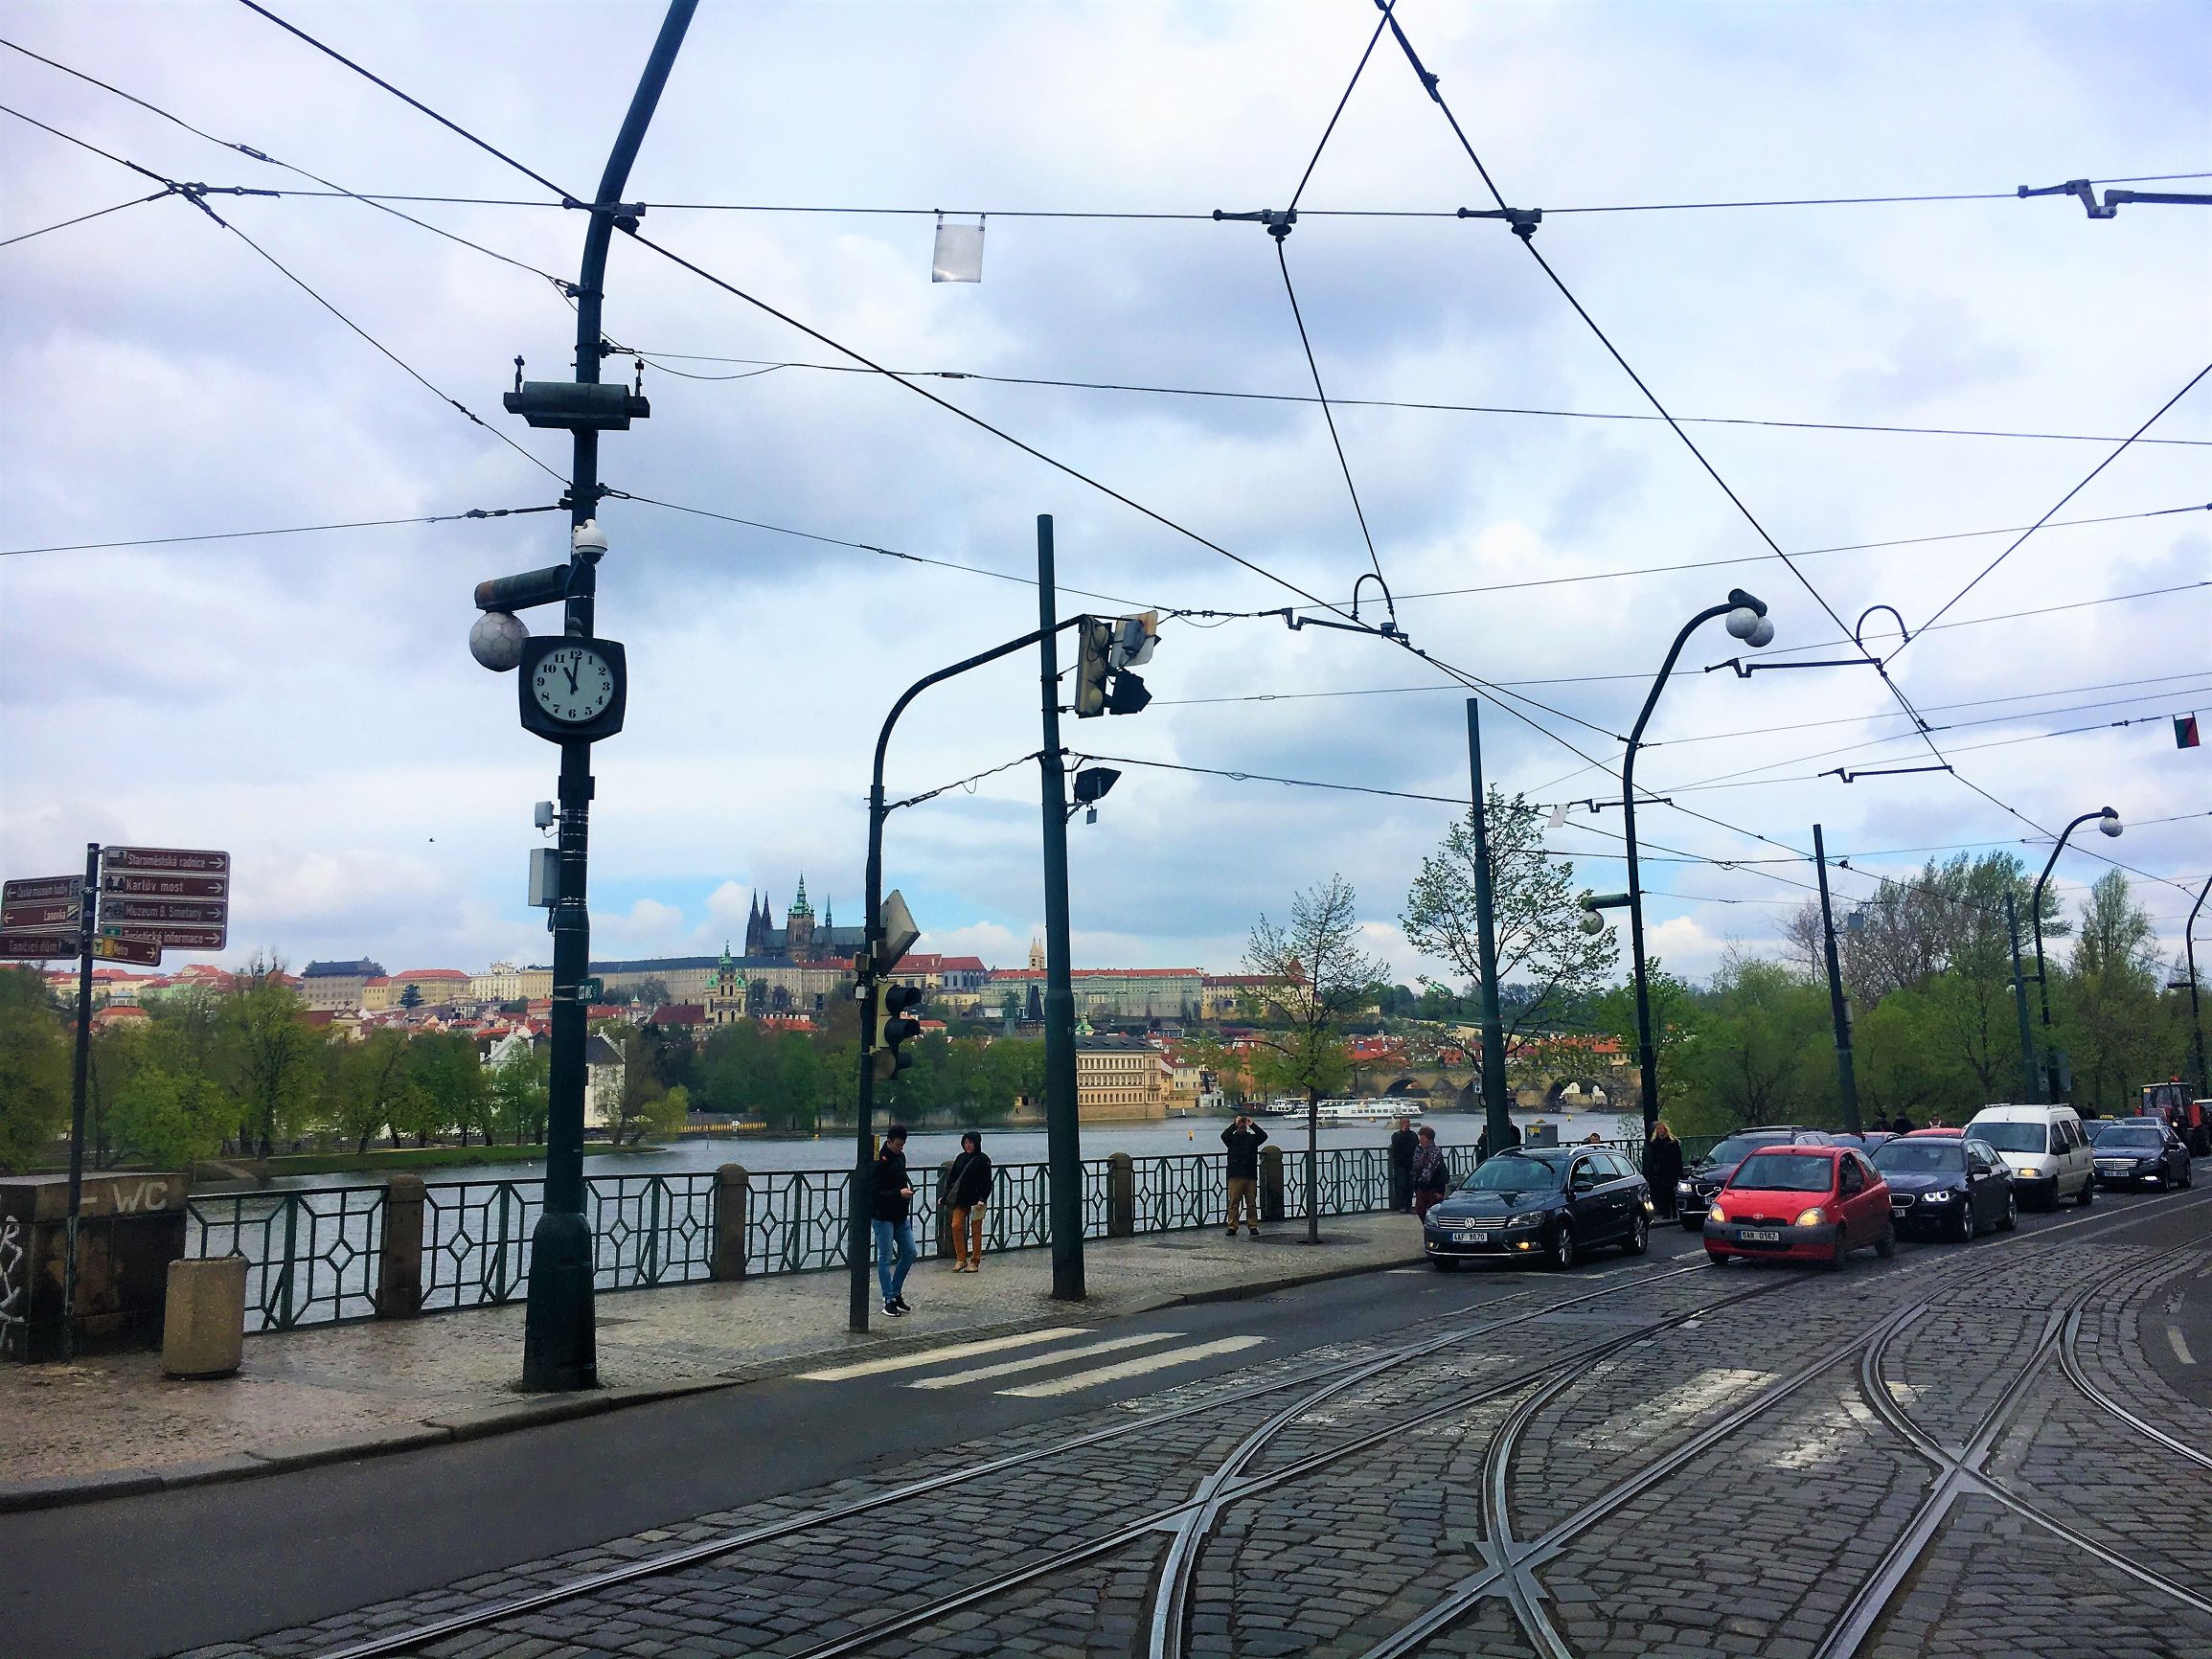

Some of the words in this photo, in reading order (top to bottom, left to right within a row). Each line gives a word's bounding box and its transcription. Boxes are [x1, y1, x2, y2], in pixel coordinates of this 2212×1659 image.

[555, 653, 565, 664] 11
[569, 650, 582, 660] 12
[588, 655, 593, 665] 1
[542, 664, 557, 673] 10
[598, 666, 606, 676] 2
[536, 676, 545, 687] 9
[602, 681, 610, 692] 3
[541, 692, 550, 702] 8
[595, 695, 604, 705] 4
[553, 703, 560, 714] 7
[568, 709, 577, 718] 6
[584, 706, 592, 716] 5
[127, 852, 177, 867] Staroměstská
[179, 857, 206, 869] radnice
[125, 878, 156, 891] Karlův
[160, 882, 184, 893] most
[43, 909, 66, 921] Lanovka
[125, 903, 158, 917] Muzeum
[169, 906, 202, 920] Smetany
[164, 931, 204, 943] informace
[112, 1181, 169, 1213] WC
